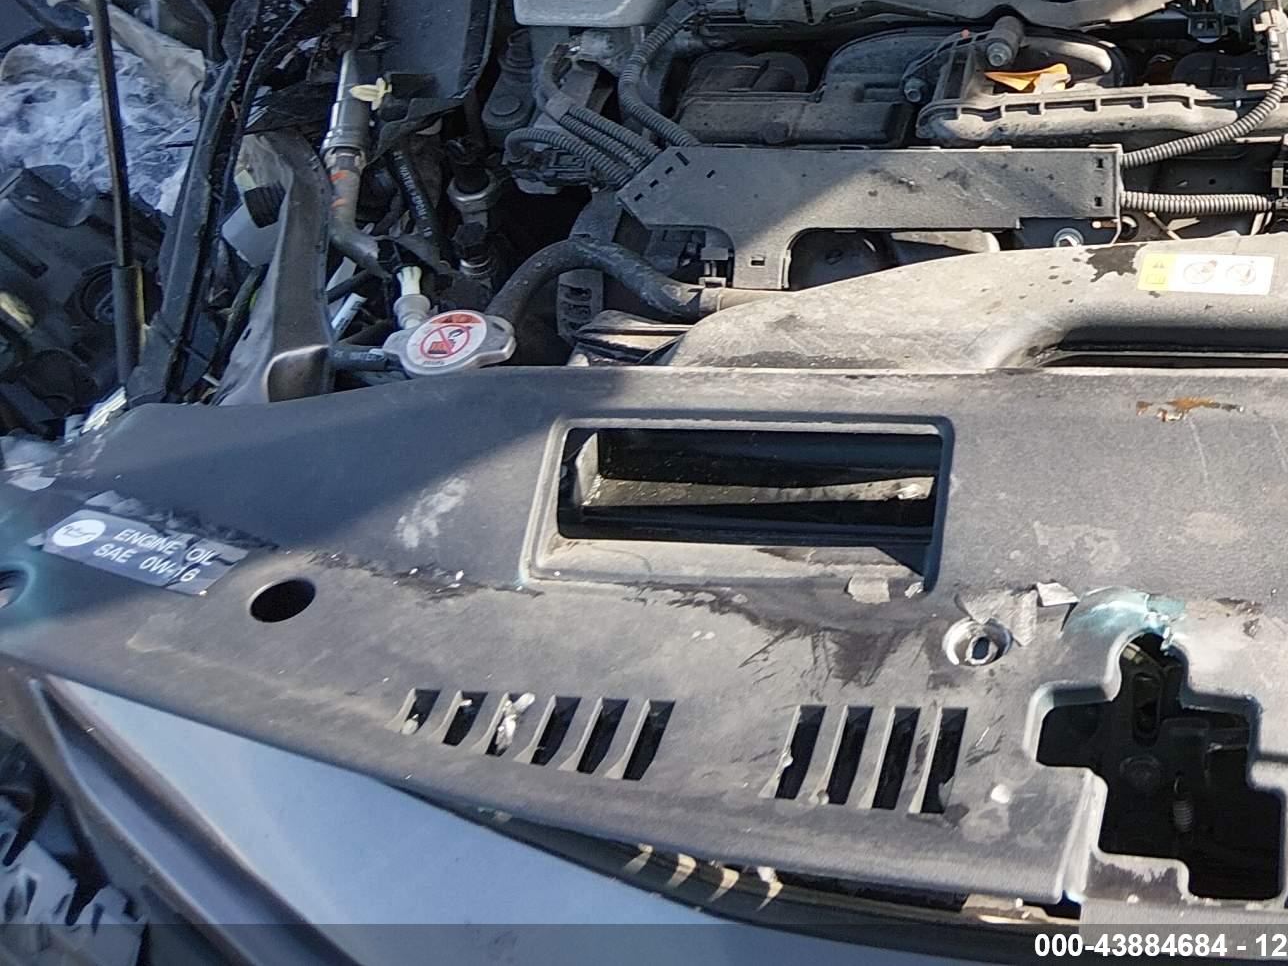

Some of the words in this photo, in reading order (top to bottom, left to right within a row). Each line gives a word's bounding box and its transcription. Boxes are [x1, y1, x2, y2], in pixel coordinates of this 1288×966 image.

[93, 543, 138, 563] SAE
[113, 528, 182, 556] ENGINE
[184, 546, 216, 566] OIL
